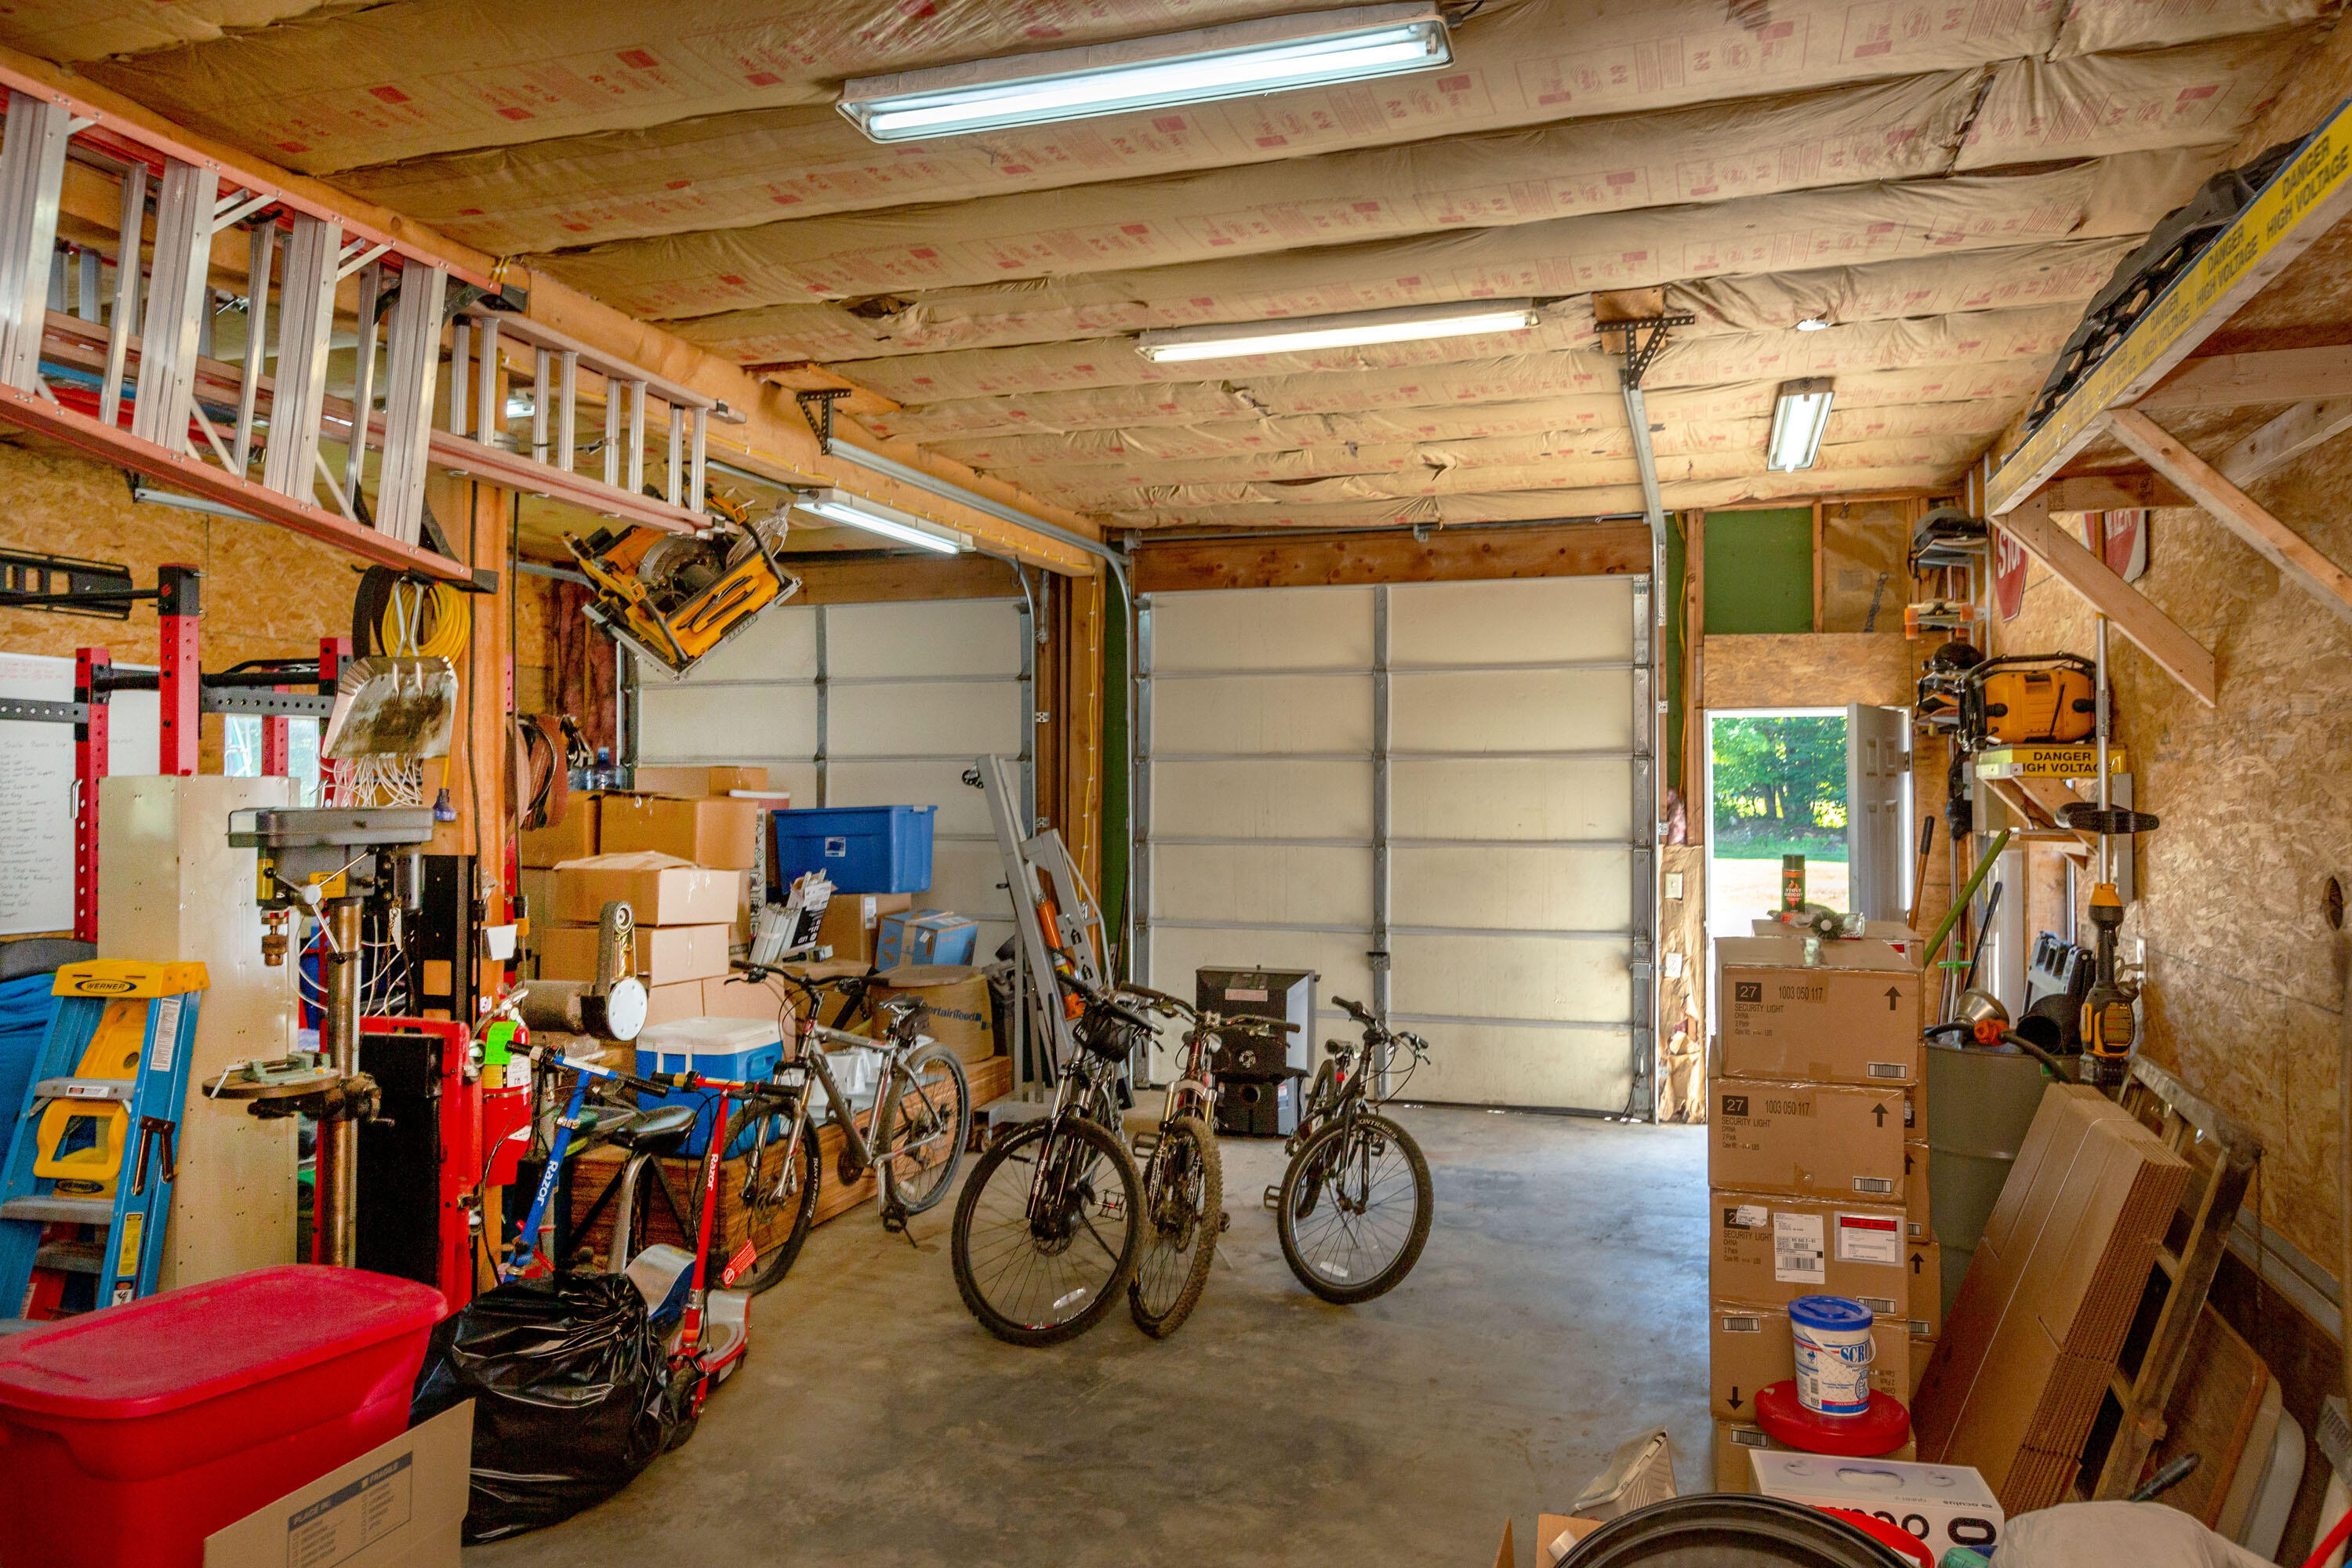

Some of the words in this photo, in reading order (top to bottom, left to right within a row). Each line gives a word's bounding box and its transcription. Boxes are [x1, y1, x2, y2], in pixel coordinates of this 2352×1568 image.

[2282, 135, 2330, 200] DANGER
[2266, 203, 2294, 241] HIGH
[2296, 144, 2350, 213] VOLTAGE
[2207, 223, 2245, 275] DANGER
[2196, 279, 2217, 310] HIGH
[2219, 233, 2259, 288] VOLTAGE
[2151, 292, 2179, 332] DANGER
[2033, 752, 2092, 761] DANGER
[2022, 763, 2046, 772] IGH
[2051, 763, 2112, 773] VOLTAG
[1740, 985, 1757, 998] 27
[1779, 986, 1795, 999] 1003
[1796, 987, 1809, 1000] 050
[1811, 988, 1823, 1001] 117
[1734, 1004, 1764, 1013] SECURITY
[1726, 1099, 1744, 1112] 27
[1766, 1100, 1781, 1114] 1003
[1784, 1102, 1795, 1115] 050
[1798, 1103, 1809, 1116] 117
[1359, 1118, 1398, 1139] ONTRAGER
[1722, 1116, 1751, 1126] SECURITY
[1753, 1119, 1771, 1127] LIGHT
[707, 1153, 719, 1191] Razor
[537, 1160, 558, 1207] Razor
[1729, 1213, 1737, 1224] 2
[1723, 1230, 1752, 1240] SECURITY
[1755, 1232, 1773, 1241] LIGHT
[370, 1461, 398, 1483] FRAGILE
